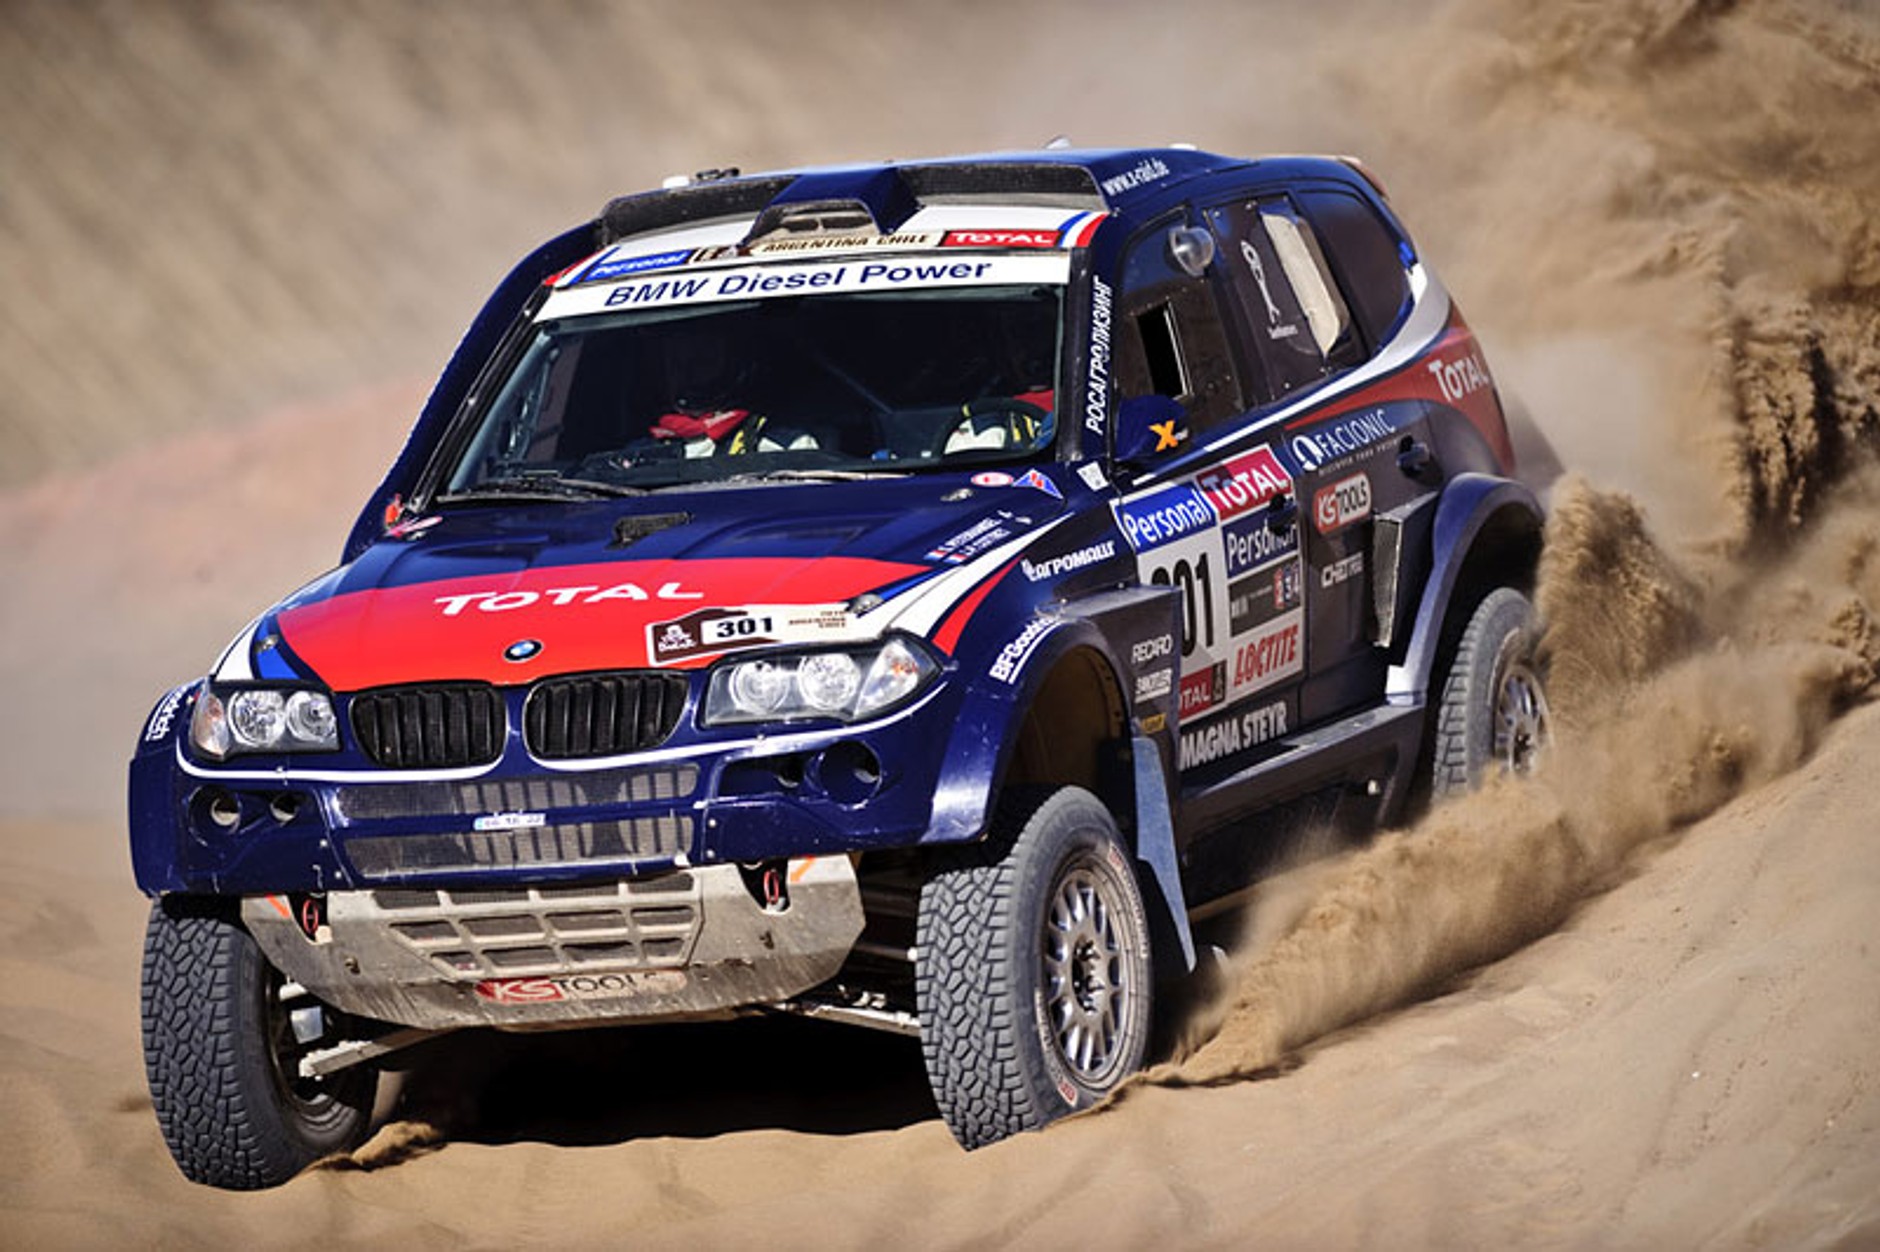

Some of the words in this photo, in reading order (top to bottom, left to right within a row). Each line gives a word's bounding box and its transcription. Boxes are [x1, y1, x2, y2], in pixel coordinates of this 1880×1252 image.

[951, 231, 1056, 246] TOTAL
[604, 277, 710, 307] BMW
[716, 267, 848, 295] Diesel
[859, 262, 993, 284] Power
[1427, 353, 1489, 402] TOTAL
[1201, 464, 1288, 509] TOTAL
[1123, 488, 1212, 548] Personal
[434, 583, 704, 615] TOTAL
[716, 616, 773, 638] 301
[1234, 624, 1299, 687] LOCTITE
[1179, 717, 1242, 772] MAGNA
[1243, 700, 1287, 749] STEYR
